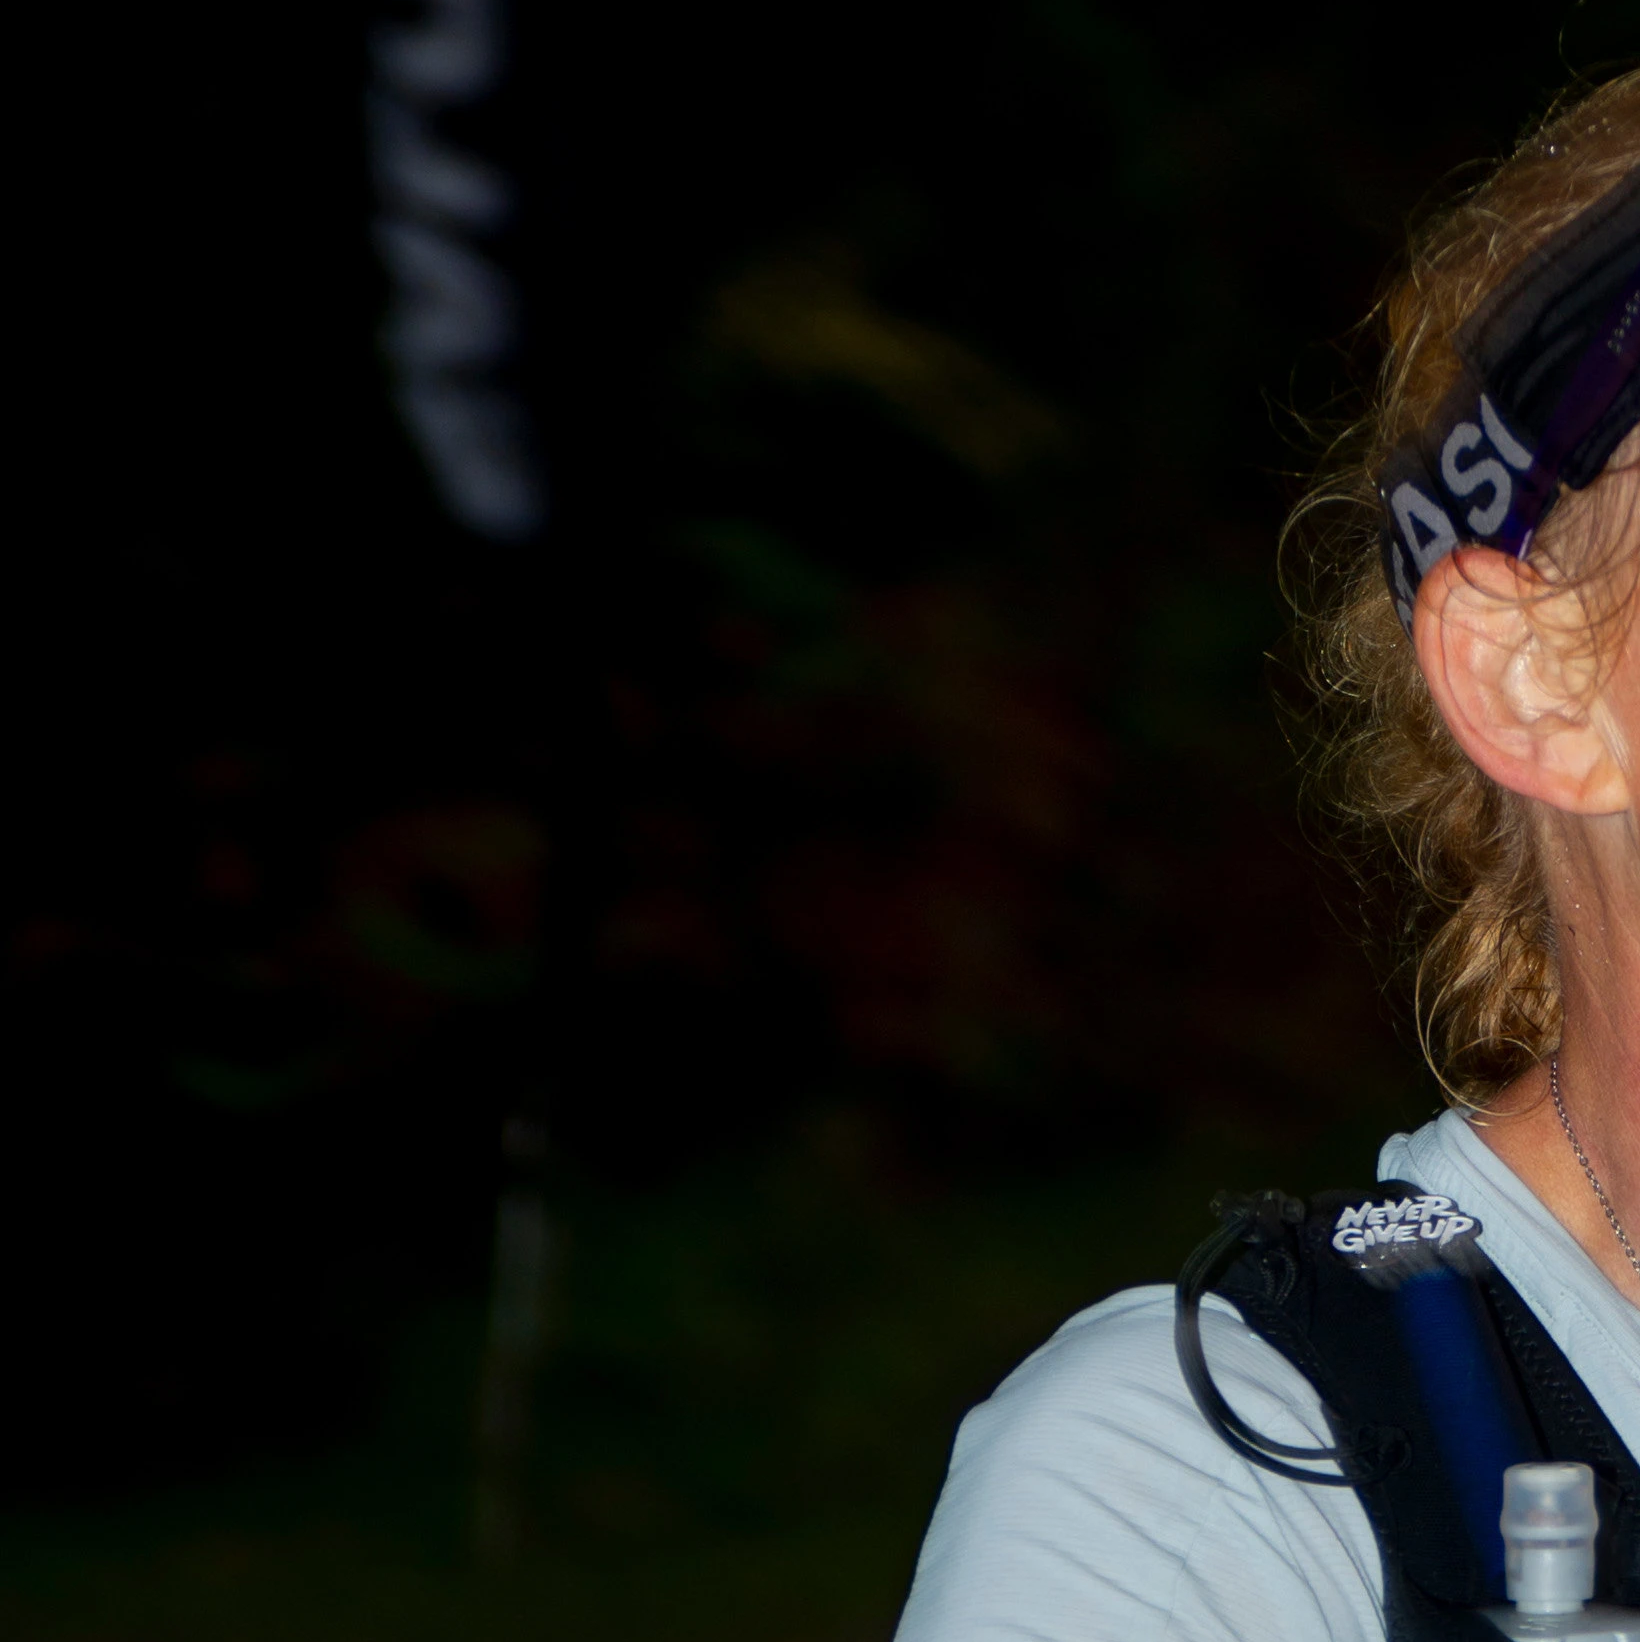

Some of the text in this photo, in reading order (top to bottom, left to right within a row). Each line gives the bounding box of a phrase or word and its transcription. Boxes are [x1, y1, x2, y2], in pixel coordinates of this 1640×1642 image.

[1335, 1195, 1459, 1230] NEVER
[1332, 1216, 1474, 1254] GIVE UP
